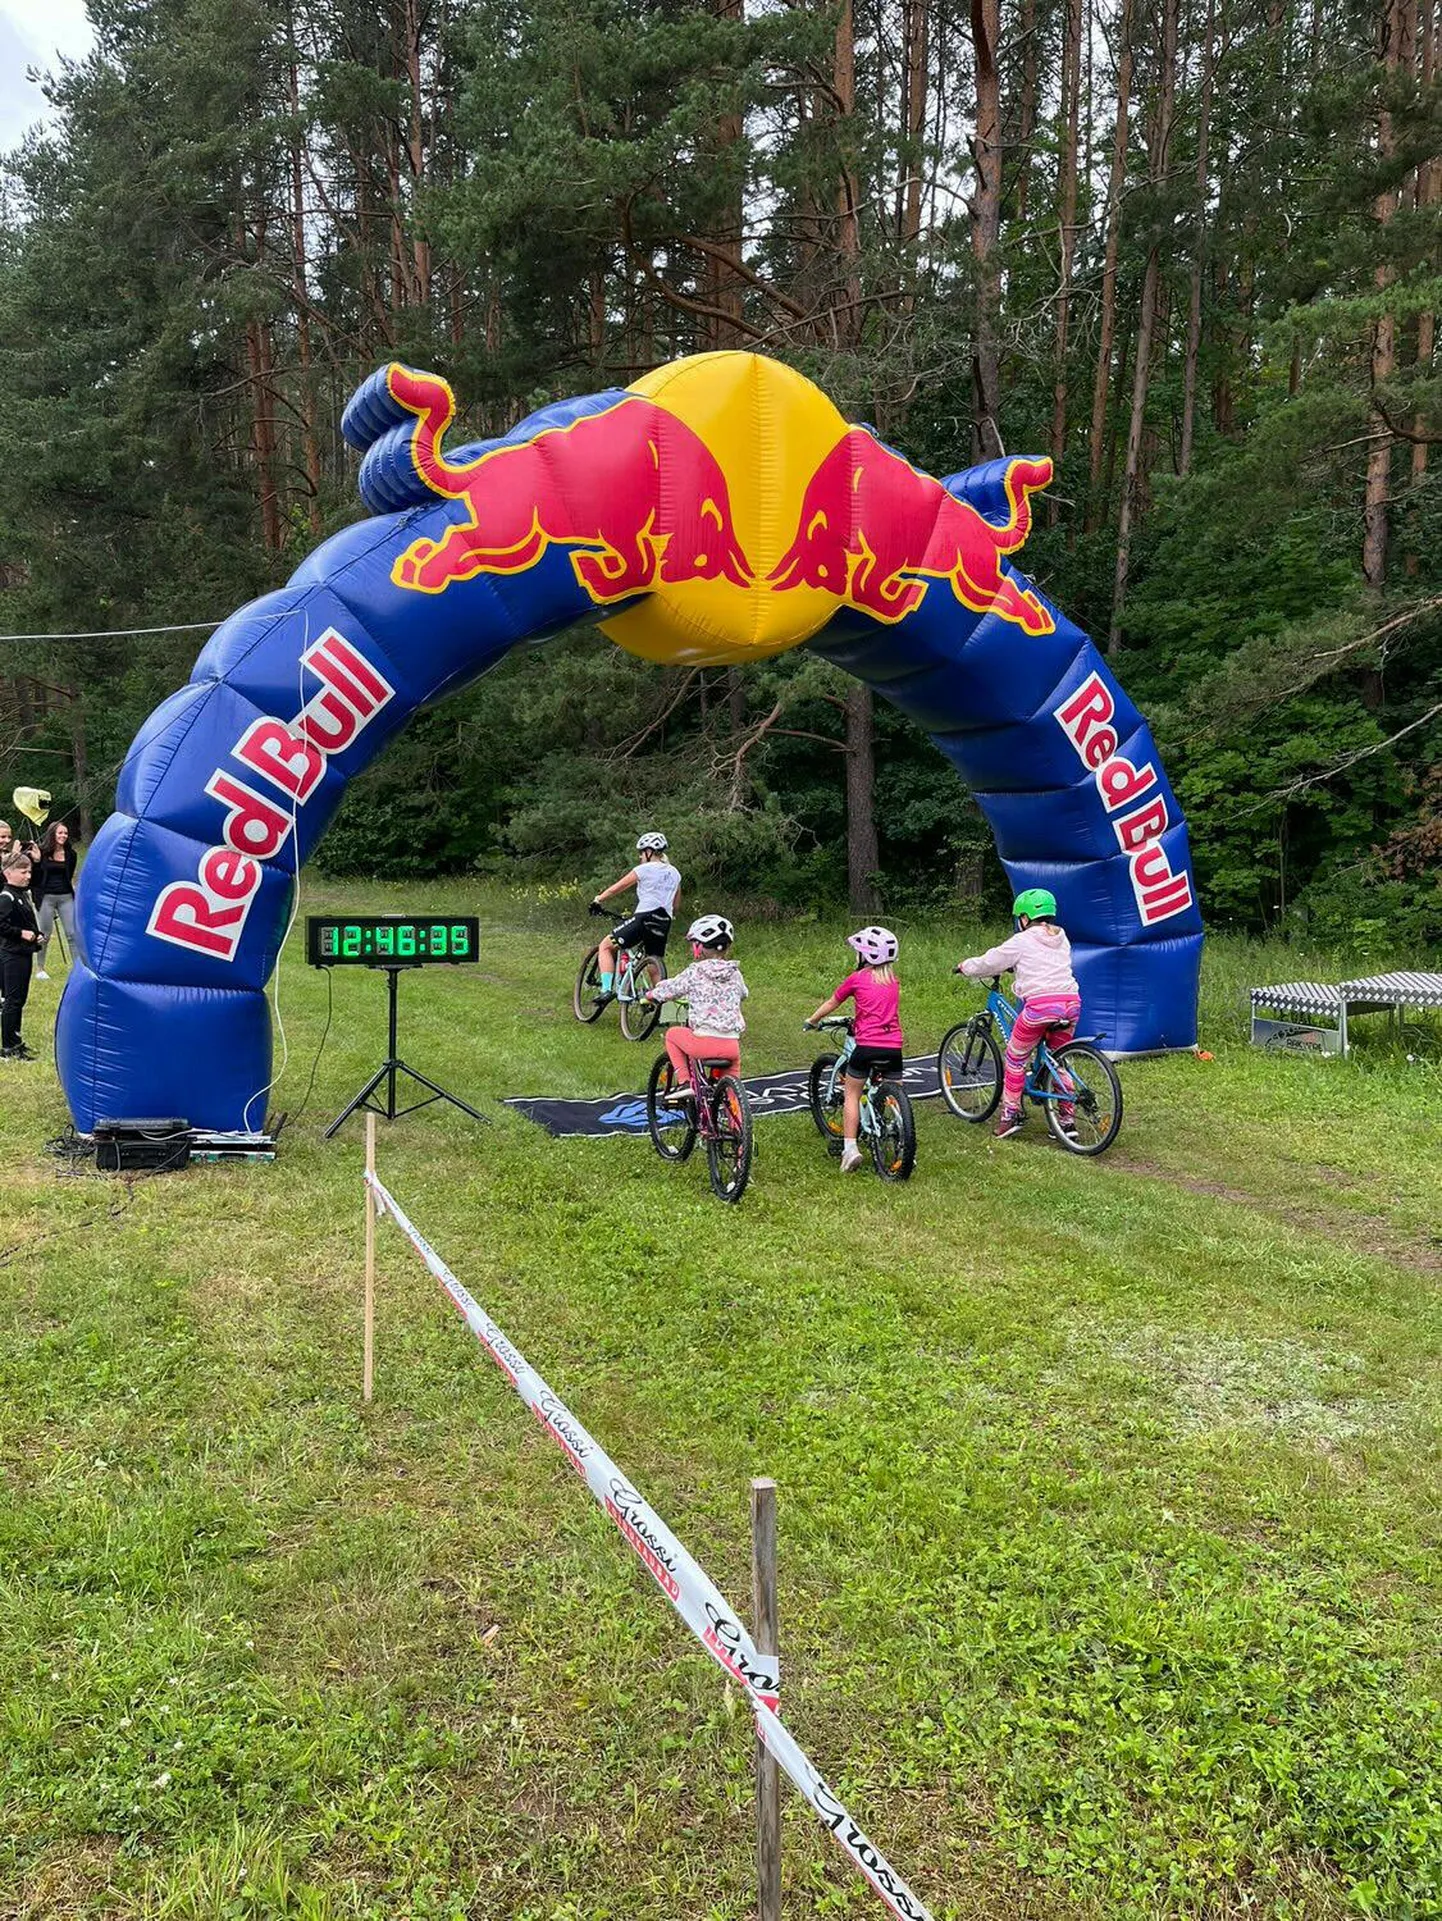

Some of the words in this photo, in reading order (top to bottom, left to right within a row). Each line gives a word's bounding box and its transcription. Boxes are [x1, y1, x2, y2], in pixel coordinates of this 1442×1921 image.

[151, 772, 293, 959] Red
[235, 630, 393, 803] Bull
[1057, 674, 1157, 810] Red
[1116, 797, 1191, 923] Bull
[331, 925, 470, 956] 12:46:35
[486, 1323, 529, 1374] Grossi
[540, 1390, 593, 1458] Grossi
[609, 1478, 677, 1572] Grossi
